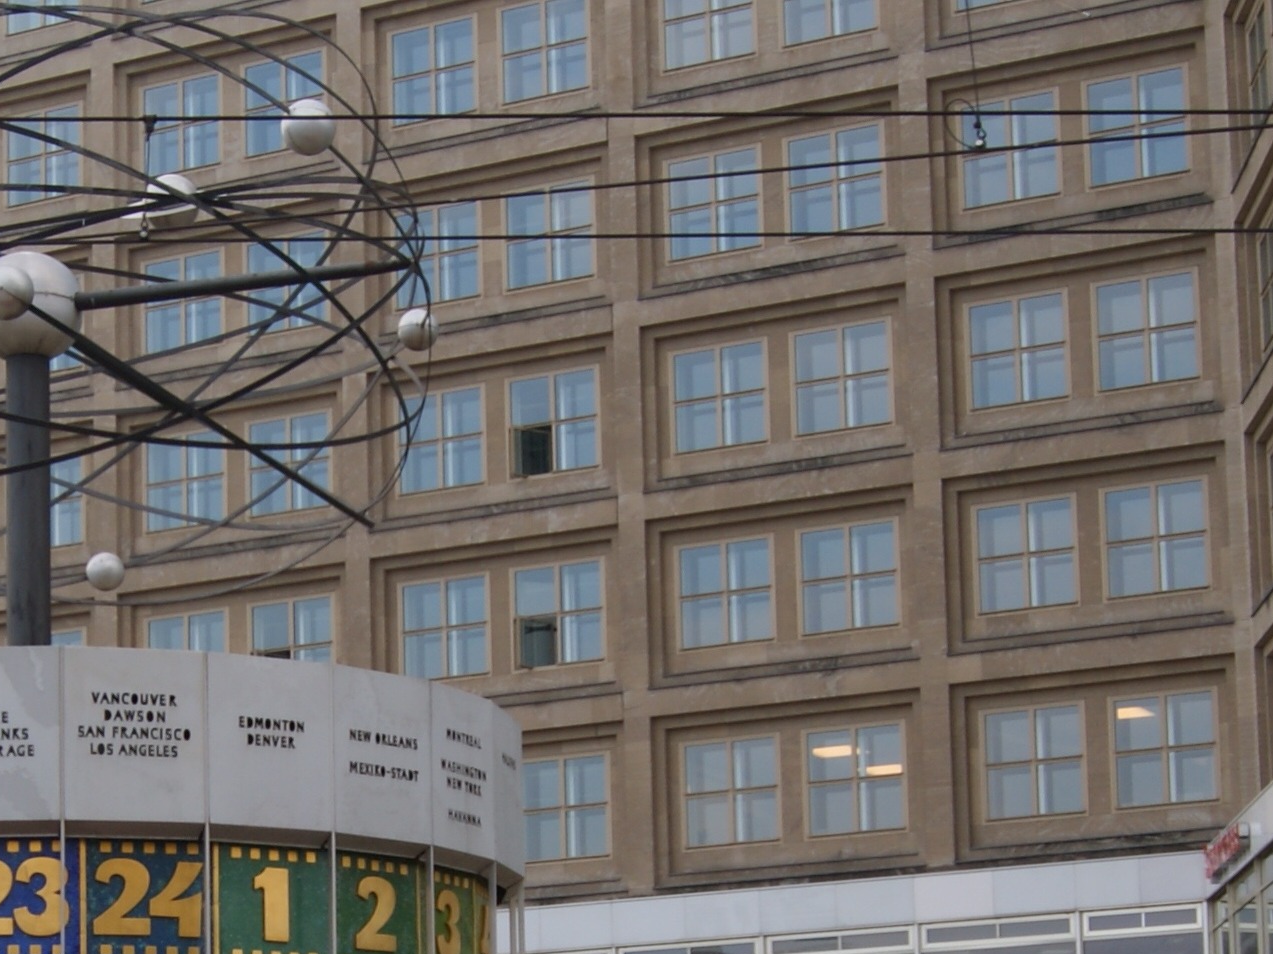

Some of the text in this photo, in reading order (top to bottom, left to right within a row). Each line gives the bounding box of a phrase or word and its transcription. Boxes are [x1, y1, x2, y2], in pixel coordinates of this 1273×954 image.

[91, 692, 178, 707] VANCOUVER
[104, 709, 166, 723] DAWSON
[238, 715, 305, 734] EDMONTON
[78, 726, 191, 741] SAN FRANCISCO
[247, 733, 296, 749] DENVER
[349, 729, 418, 750] NEW ORLEANS
[89, 743, 179, 758] LOS ANGELES
[349, 761, 419, 782] MEXIKO-STADT
[93, 858, 203, 938] 24
[253, 866, 290, 943] 1
[355, 875, 397, 952] 2
